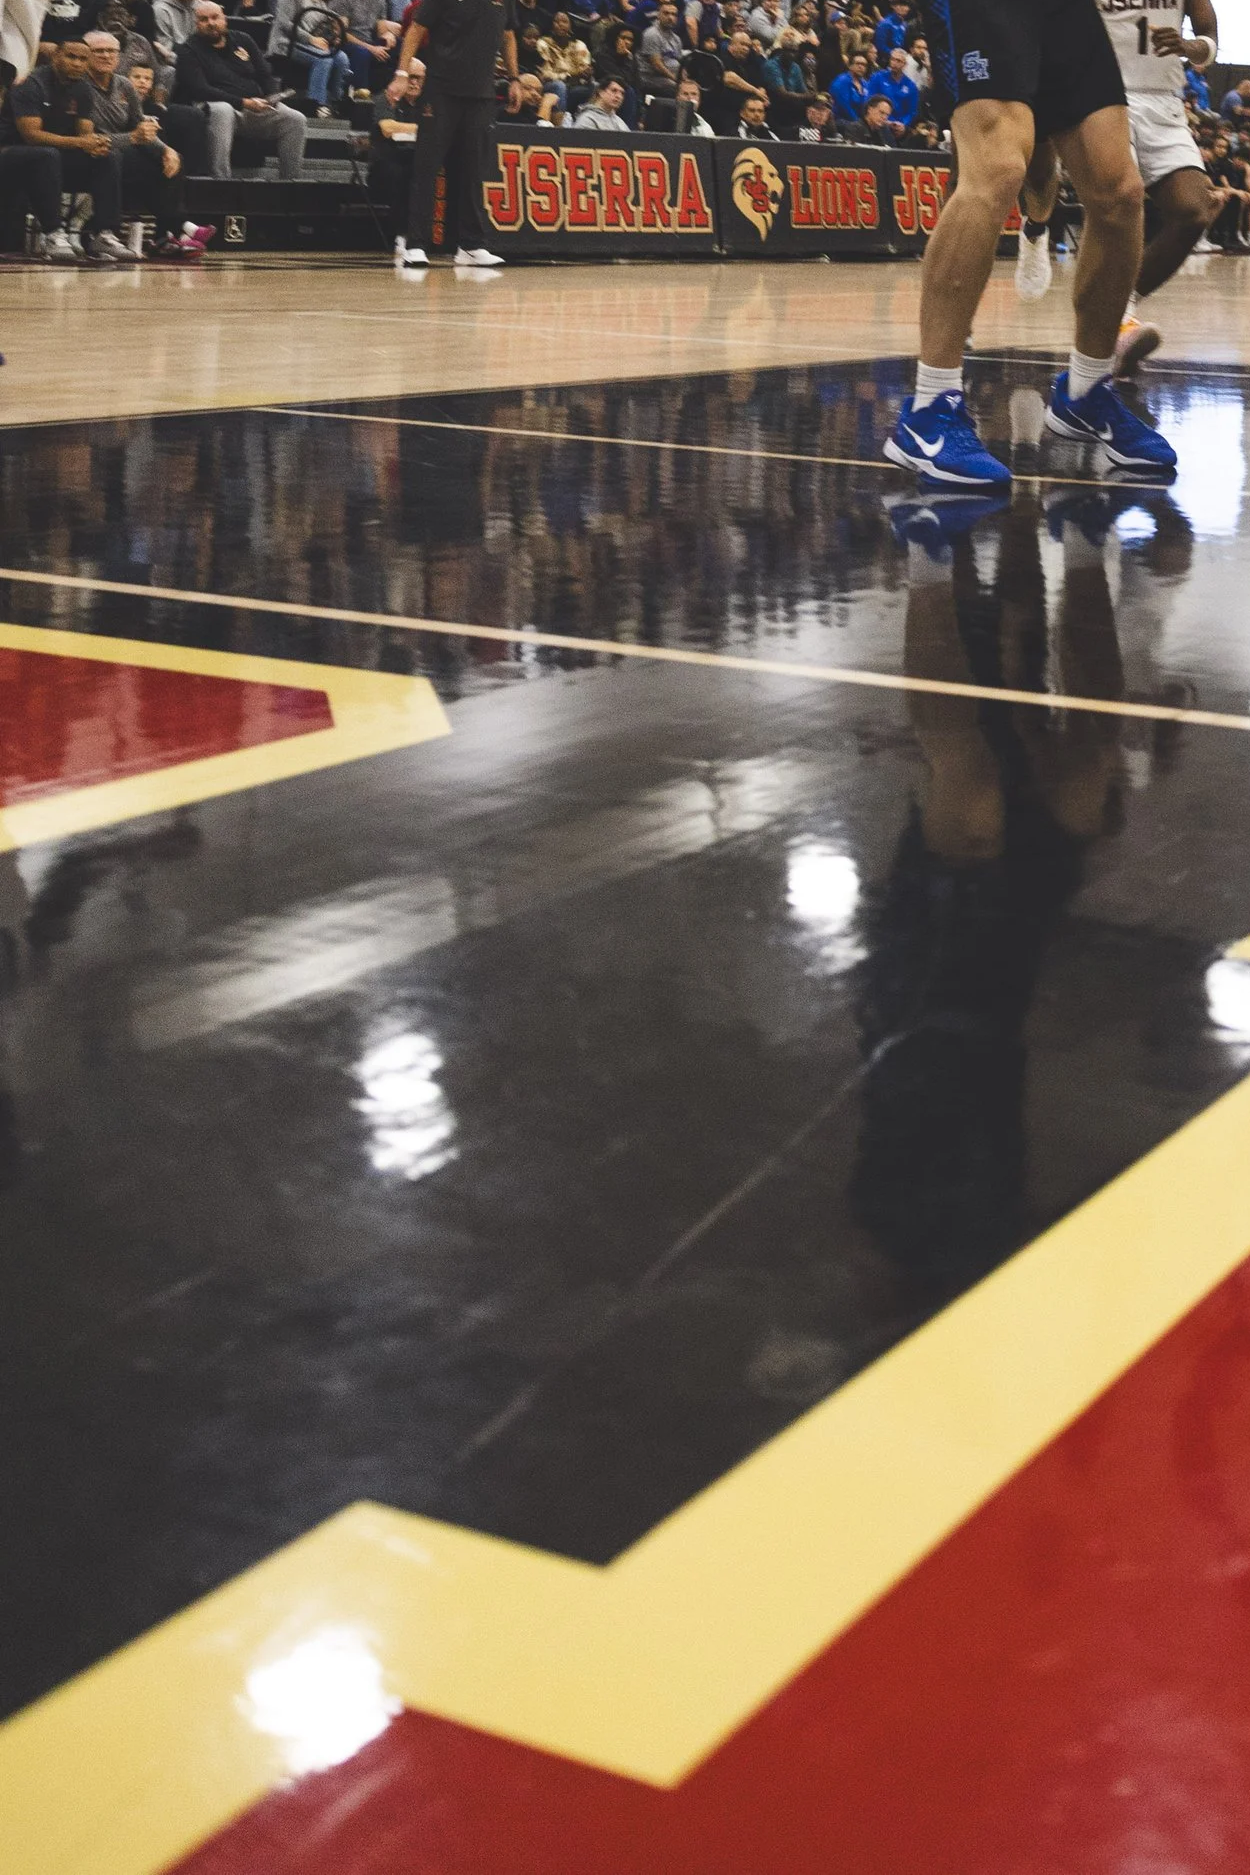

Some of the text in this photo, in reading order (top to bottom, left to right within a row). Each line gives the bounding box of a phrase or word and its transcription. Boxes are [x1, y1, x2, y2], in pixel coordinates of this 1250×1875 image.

[1135, 15, 1148, 56] 1
[482, 143, 713, 234] JSERRA
[786, 164, 880, 230] LIONS
